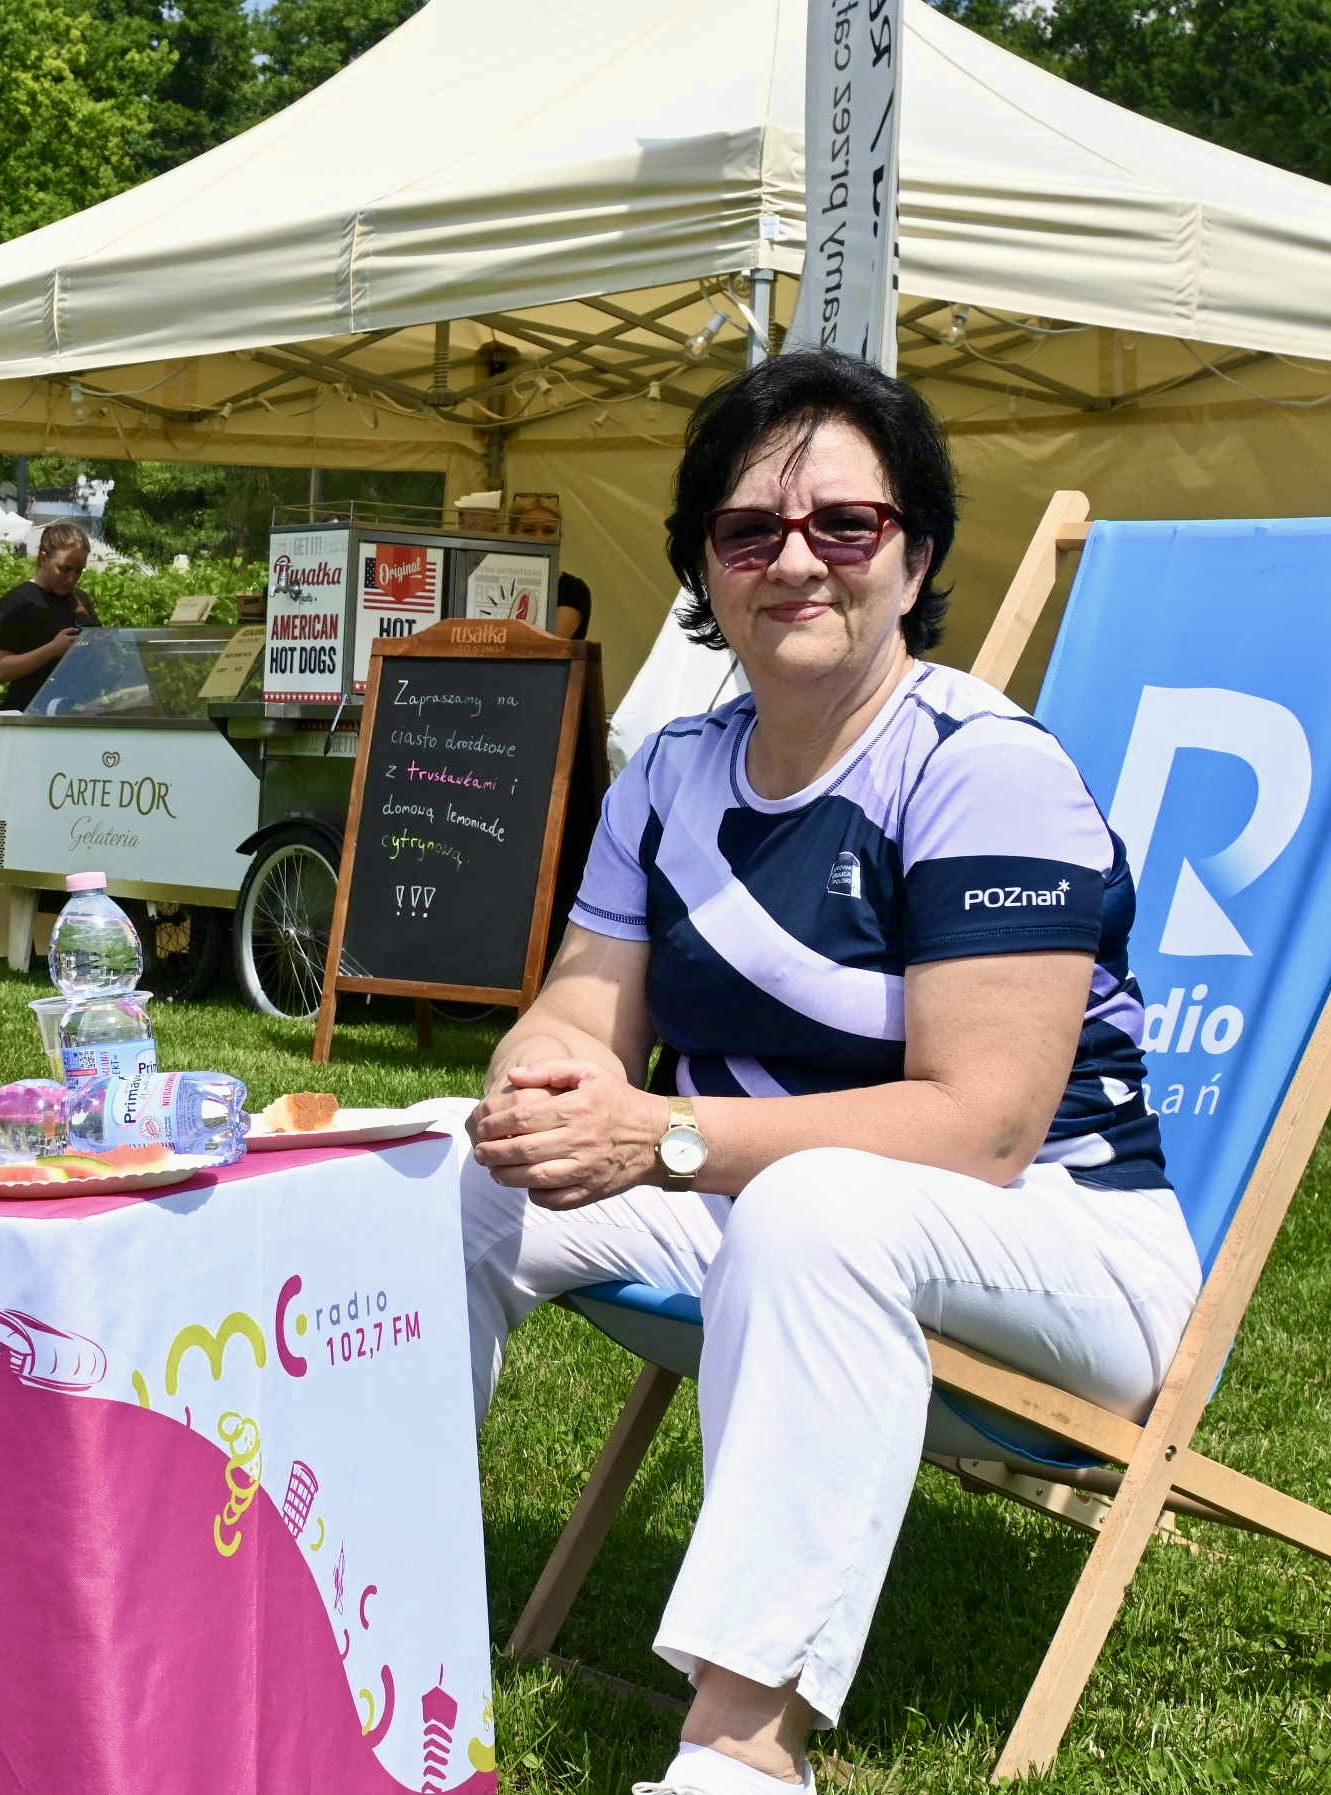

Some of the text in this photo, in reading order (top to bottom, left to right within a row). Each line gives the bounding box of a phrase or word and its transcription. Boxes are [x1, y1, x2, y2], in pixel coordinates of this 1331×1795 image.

[379, 556, 422, 586] Original
[270, 613, 339, 641] AMERICAN
[379, 616, 418, 638] HOT
[269, 645, 337, 675] HOT DOGS
[393, 679, 519, 717] Zapraszamy na
[390, 724, 438, 749] ciasto
[48, 771, 177, 820] CARTE D'OR
[510, 778, 519, 796] i
[68, 815, 141, 852] Gelateria
[315, 1290, 388, 1331] radio
[326, 1311, 421, 1367] 102,7 FM
